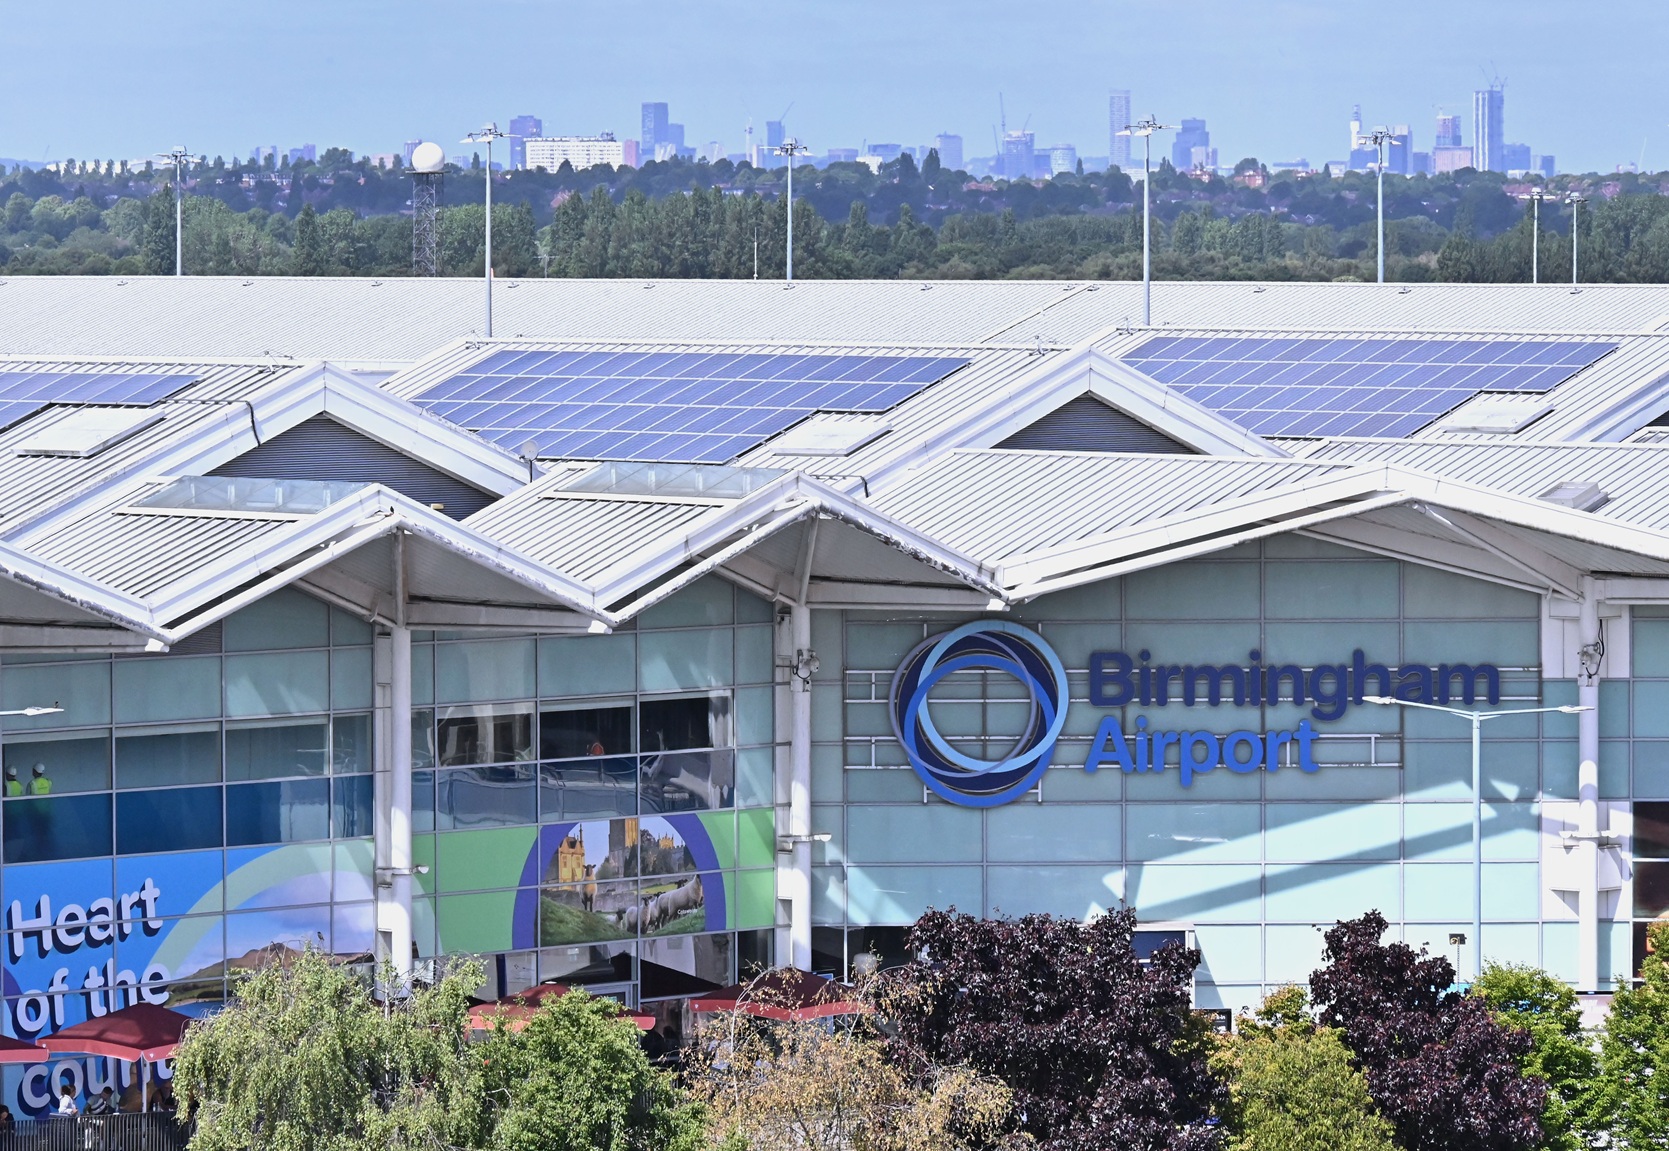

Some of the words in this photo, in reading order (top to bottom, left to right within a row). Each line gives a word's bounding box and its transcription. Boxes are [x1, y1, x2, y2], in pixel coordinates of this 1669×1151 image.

[1089, 648, 1500, 721] Birmingham
[1084, 715, 1319, 788] Airport
[11, 877, 163, 957] Heart
[16, 967, 69, 1032] of
[84, 957, 171, 1018] the
